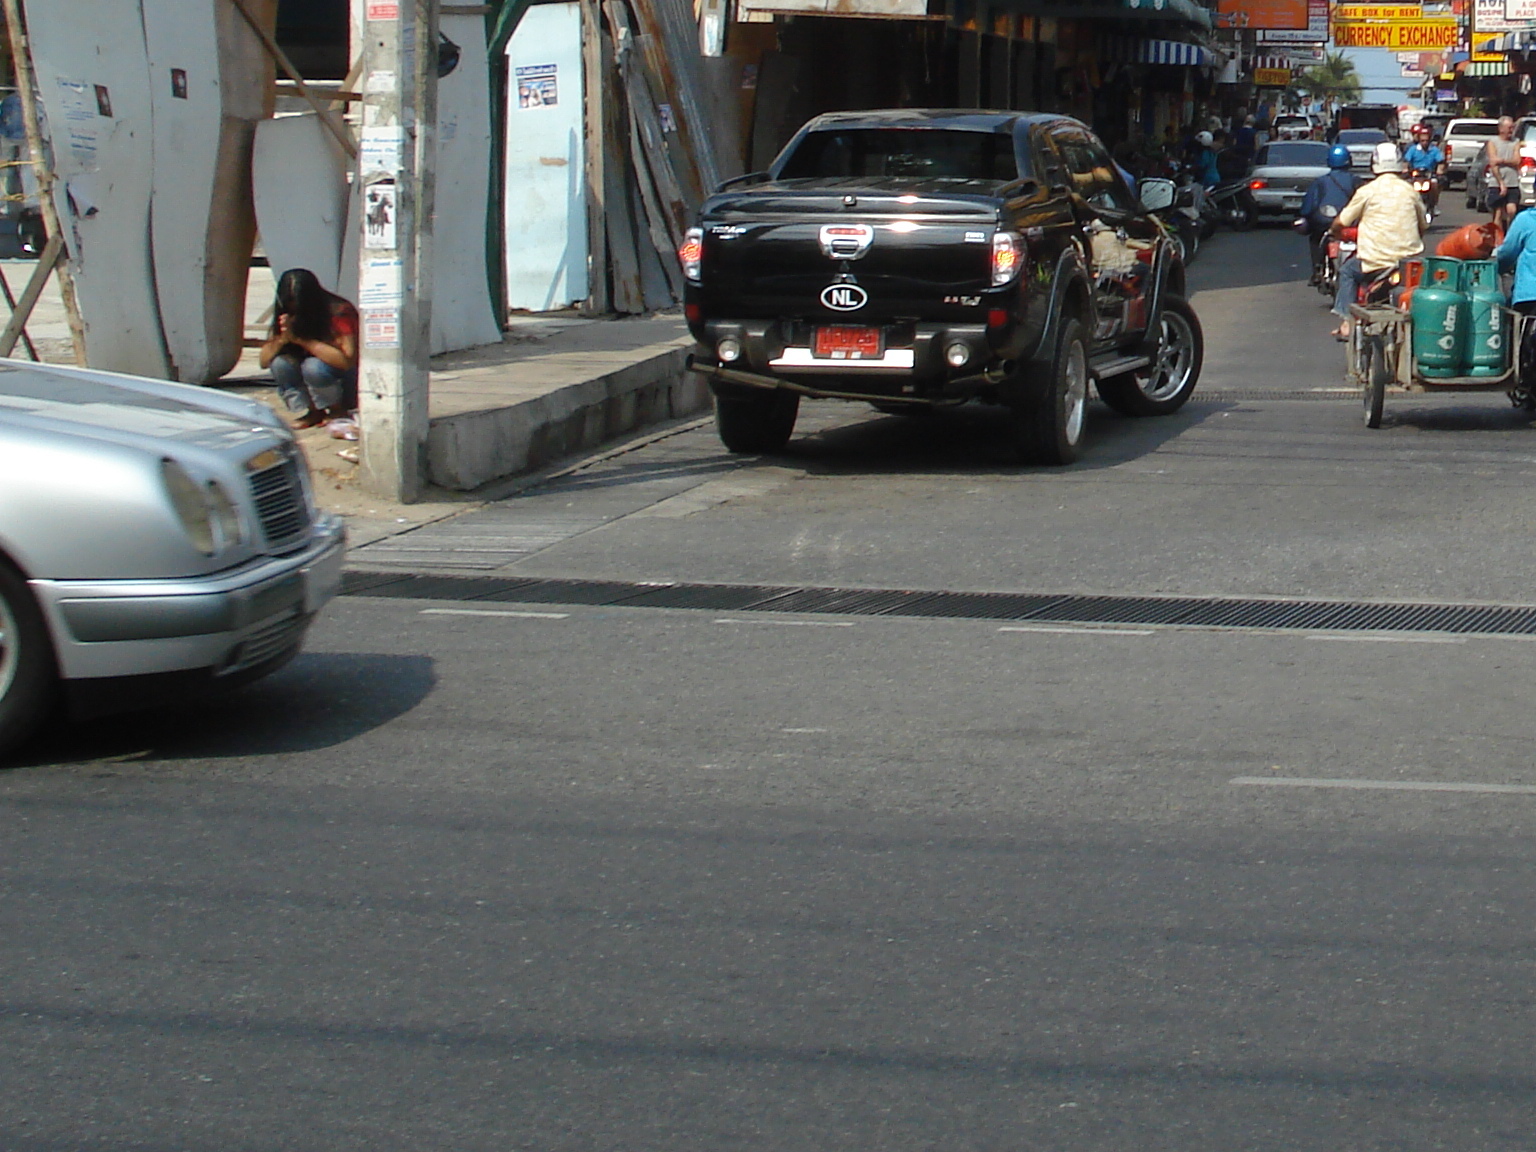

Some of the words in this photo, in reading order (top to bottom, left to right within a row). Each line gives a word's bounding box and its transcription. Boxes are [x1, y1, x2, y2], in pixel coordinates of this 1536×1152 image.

[1361, 8, 1379, 17] BOX
[1399, 8, 1421, 17] RENT
[1515, 9, 1535, 17] PLACE
[1335, 26, 1394, 47] CURRENCY
[1399, 26, 1457, 47] EXCHANGE
[831, 289, 858, 306] NL
